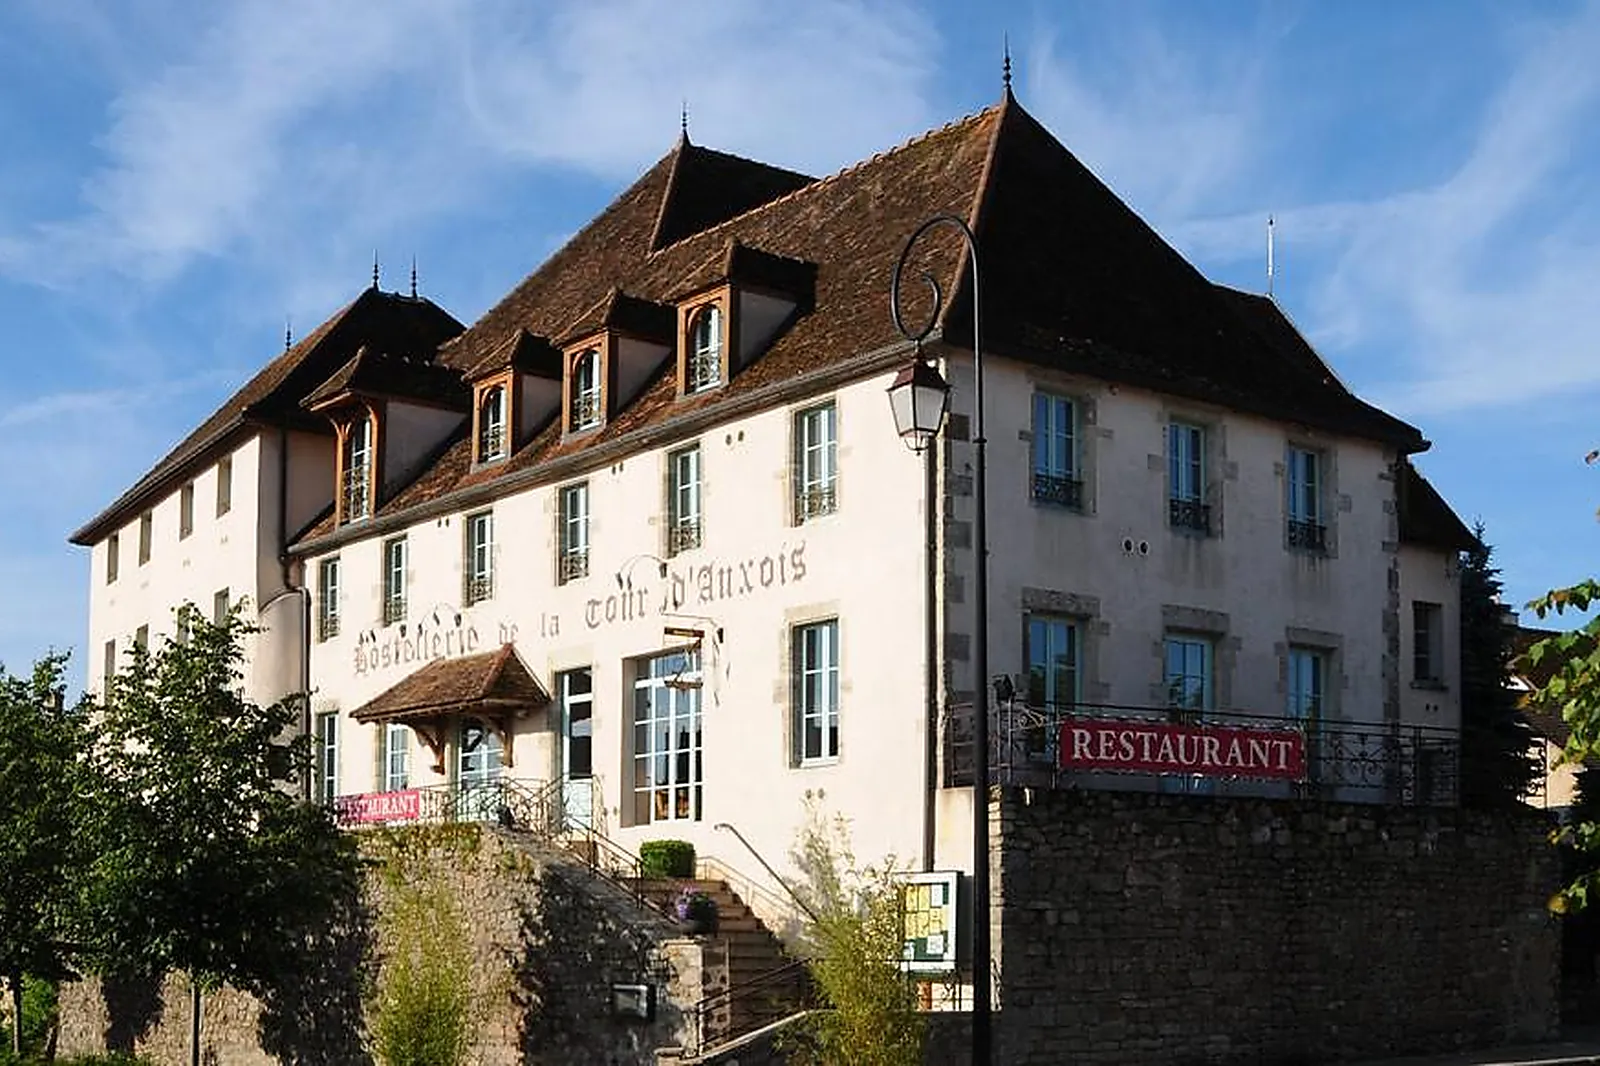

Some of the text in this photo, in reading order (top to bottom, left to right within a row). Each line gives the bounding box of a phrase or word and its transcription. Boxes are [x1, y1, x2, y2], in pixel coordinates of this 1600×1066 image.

[498, 619, 519, 644] de
[540, 611, 560, 637] la
[584, 588, 650, 629] Tour
[1071, 728, 1294, 769] RESTAURANT
